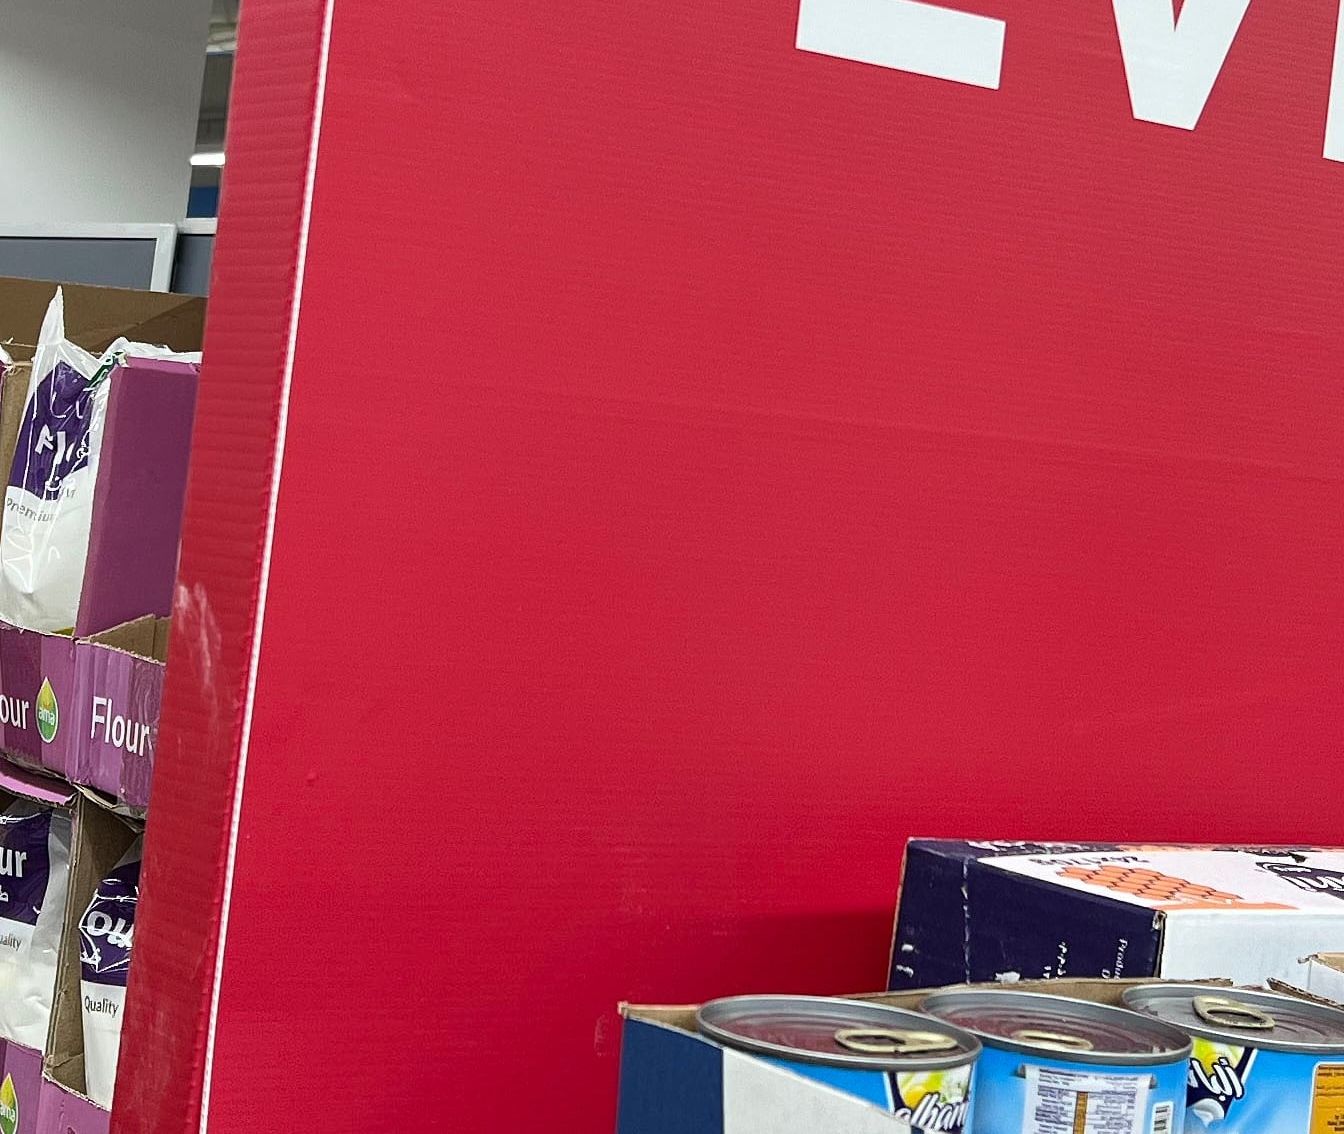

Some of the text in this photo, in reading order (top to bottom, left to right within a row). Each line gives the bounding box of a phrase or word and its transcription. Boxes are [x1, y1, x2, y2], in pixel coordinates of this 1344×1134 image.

[37, 708, 56, 726] ama
[90, 695, 151, 758] Flour
[84, 995, 120, 1018] Quality
